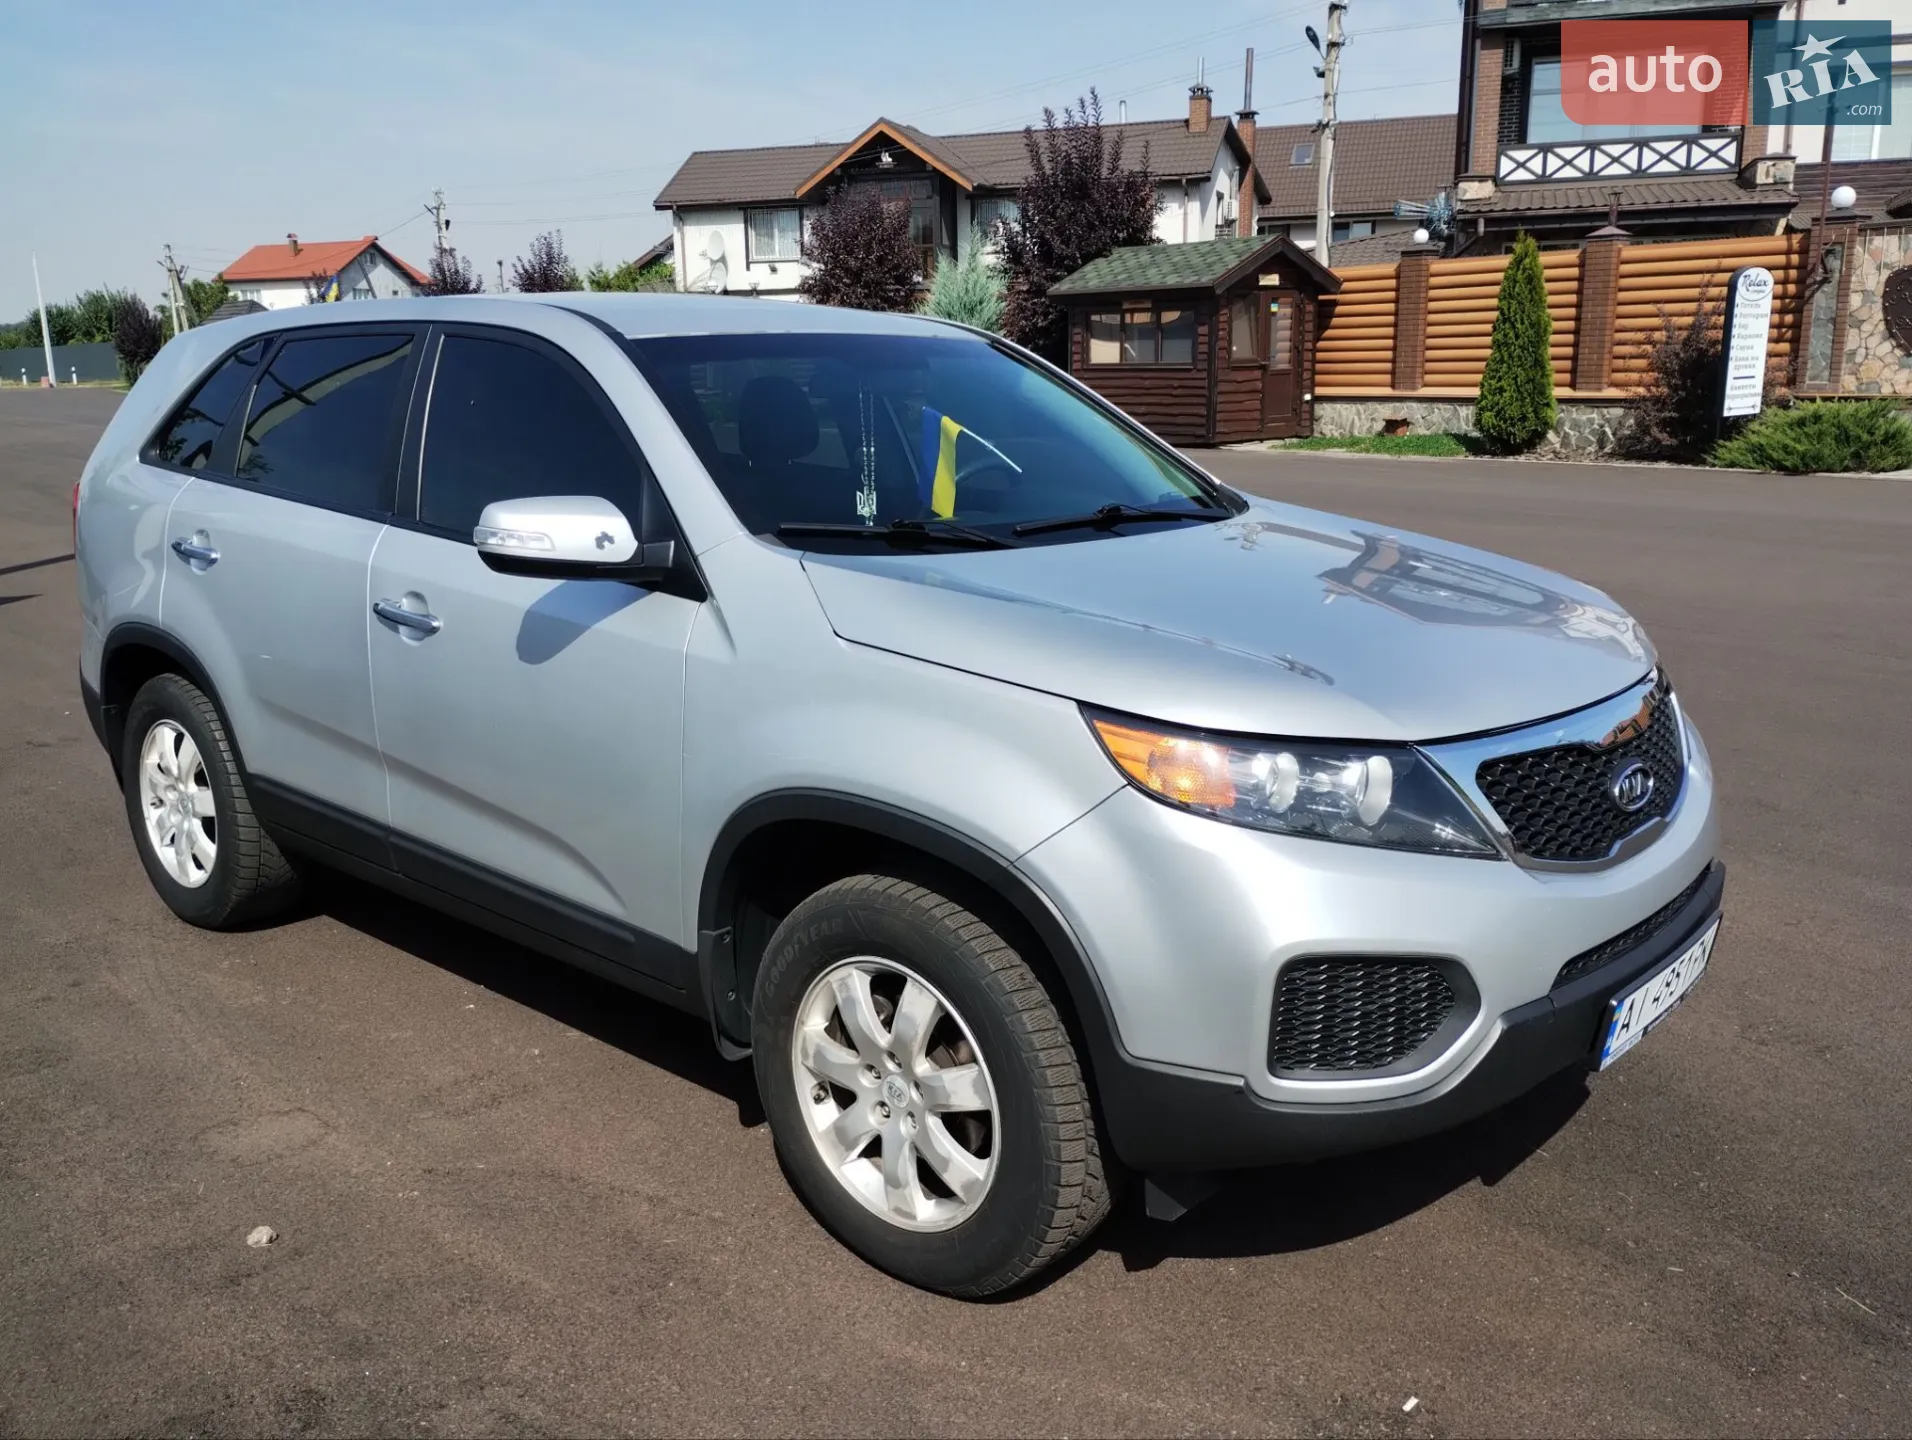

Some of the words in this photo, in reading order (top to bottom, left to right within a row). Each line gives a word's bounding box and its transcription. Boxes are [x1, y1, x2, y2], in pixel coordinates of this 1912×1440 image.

[1741, 272, 1769, 292] Relax
[764, 918, 844, 997] GOODYEAR
[1616, 986, 1649, 1041] AI
[1652, 950, 1695, 1010] 4951
